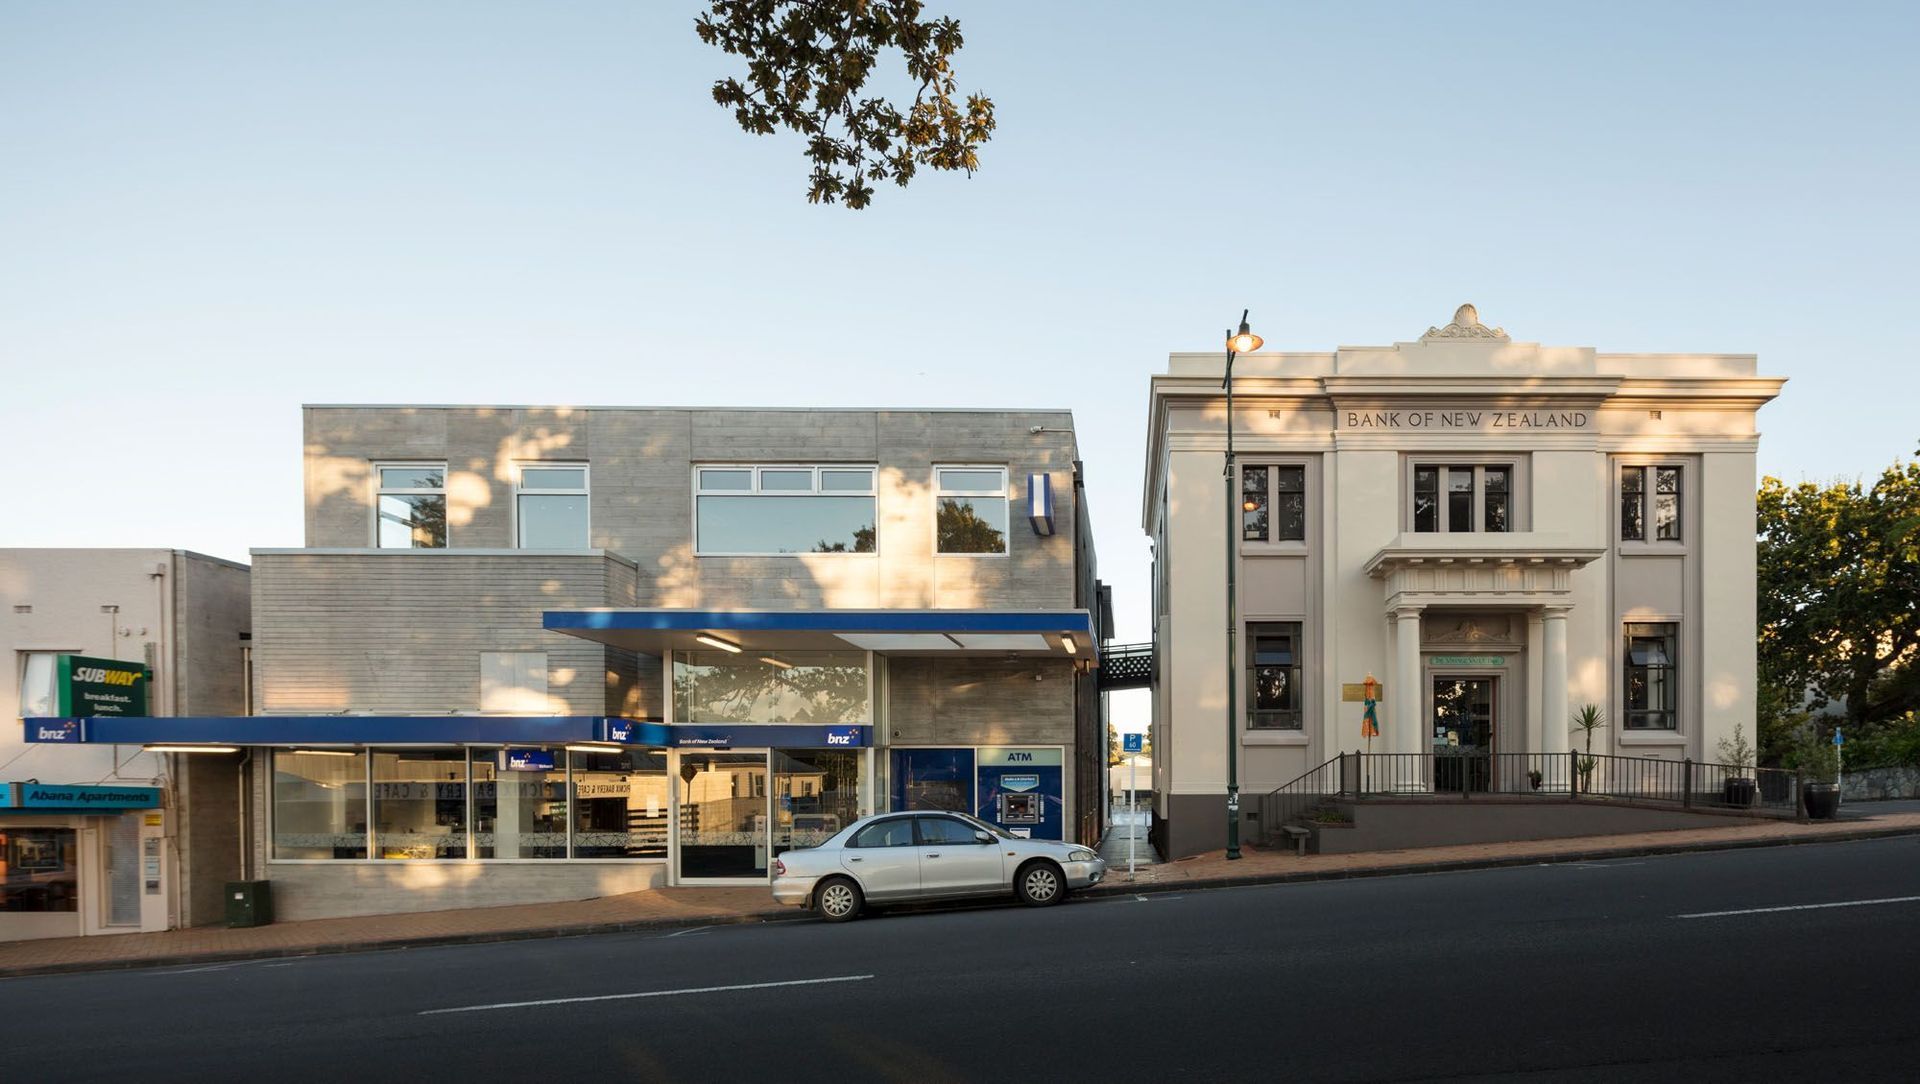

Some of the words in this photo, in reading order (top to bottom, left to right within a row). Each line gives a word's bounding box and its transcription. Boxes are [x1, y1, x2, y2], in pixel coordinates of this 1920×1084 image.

[1348, 412, 1400, 427] BANK
[1408, 412, 1434, 427] OF
[1441, 412, 1482, 427] NEW
[1492, 412, 1587, 427] ZEALAND
[72, 667, 143, 686] SUBWAY
[38, 727, 66, 740] bnz
[612, 728, 627, 740] bnz
[827, 733, 850, 744] bnz
[510, 757, 526, 768] bnz
[1007, 752, 1033, 761] ATM
[30, 790, 73, 801] Abana
[77, 791, 149, 803] Apartments
